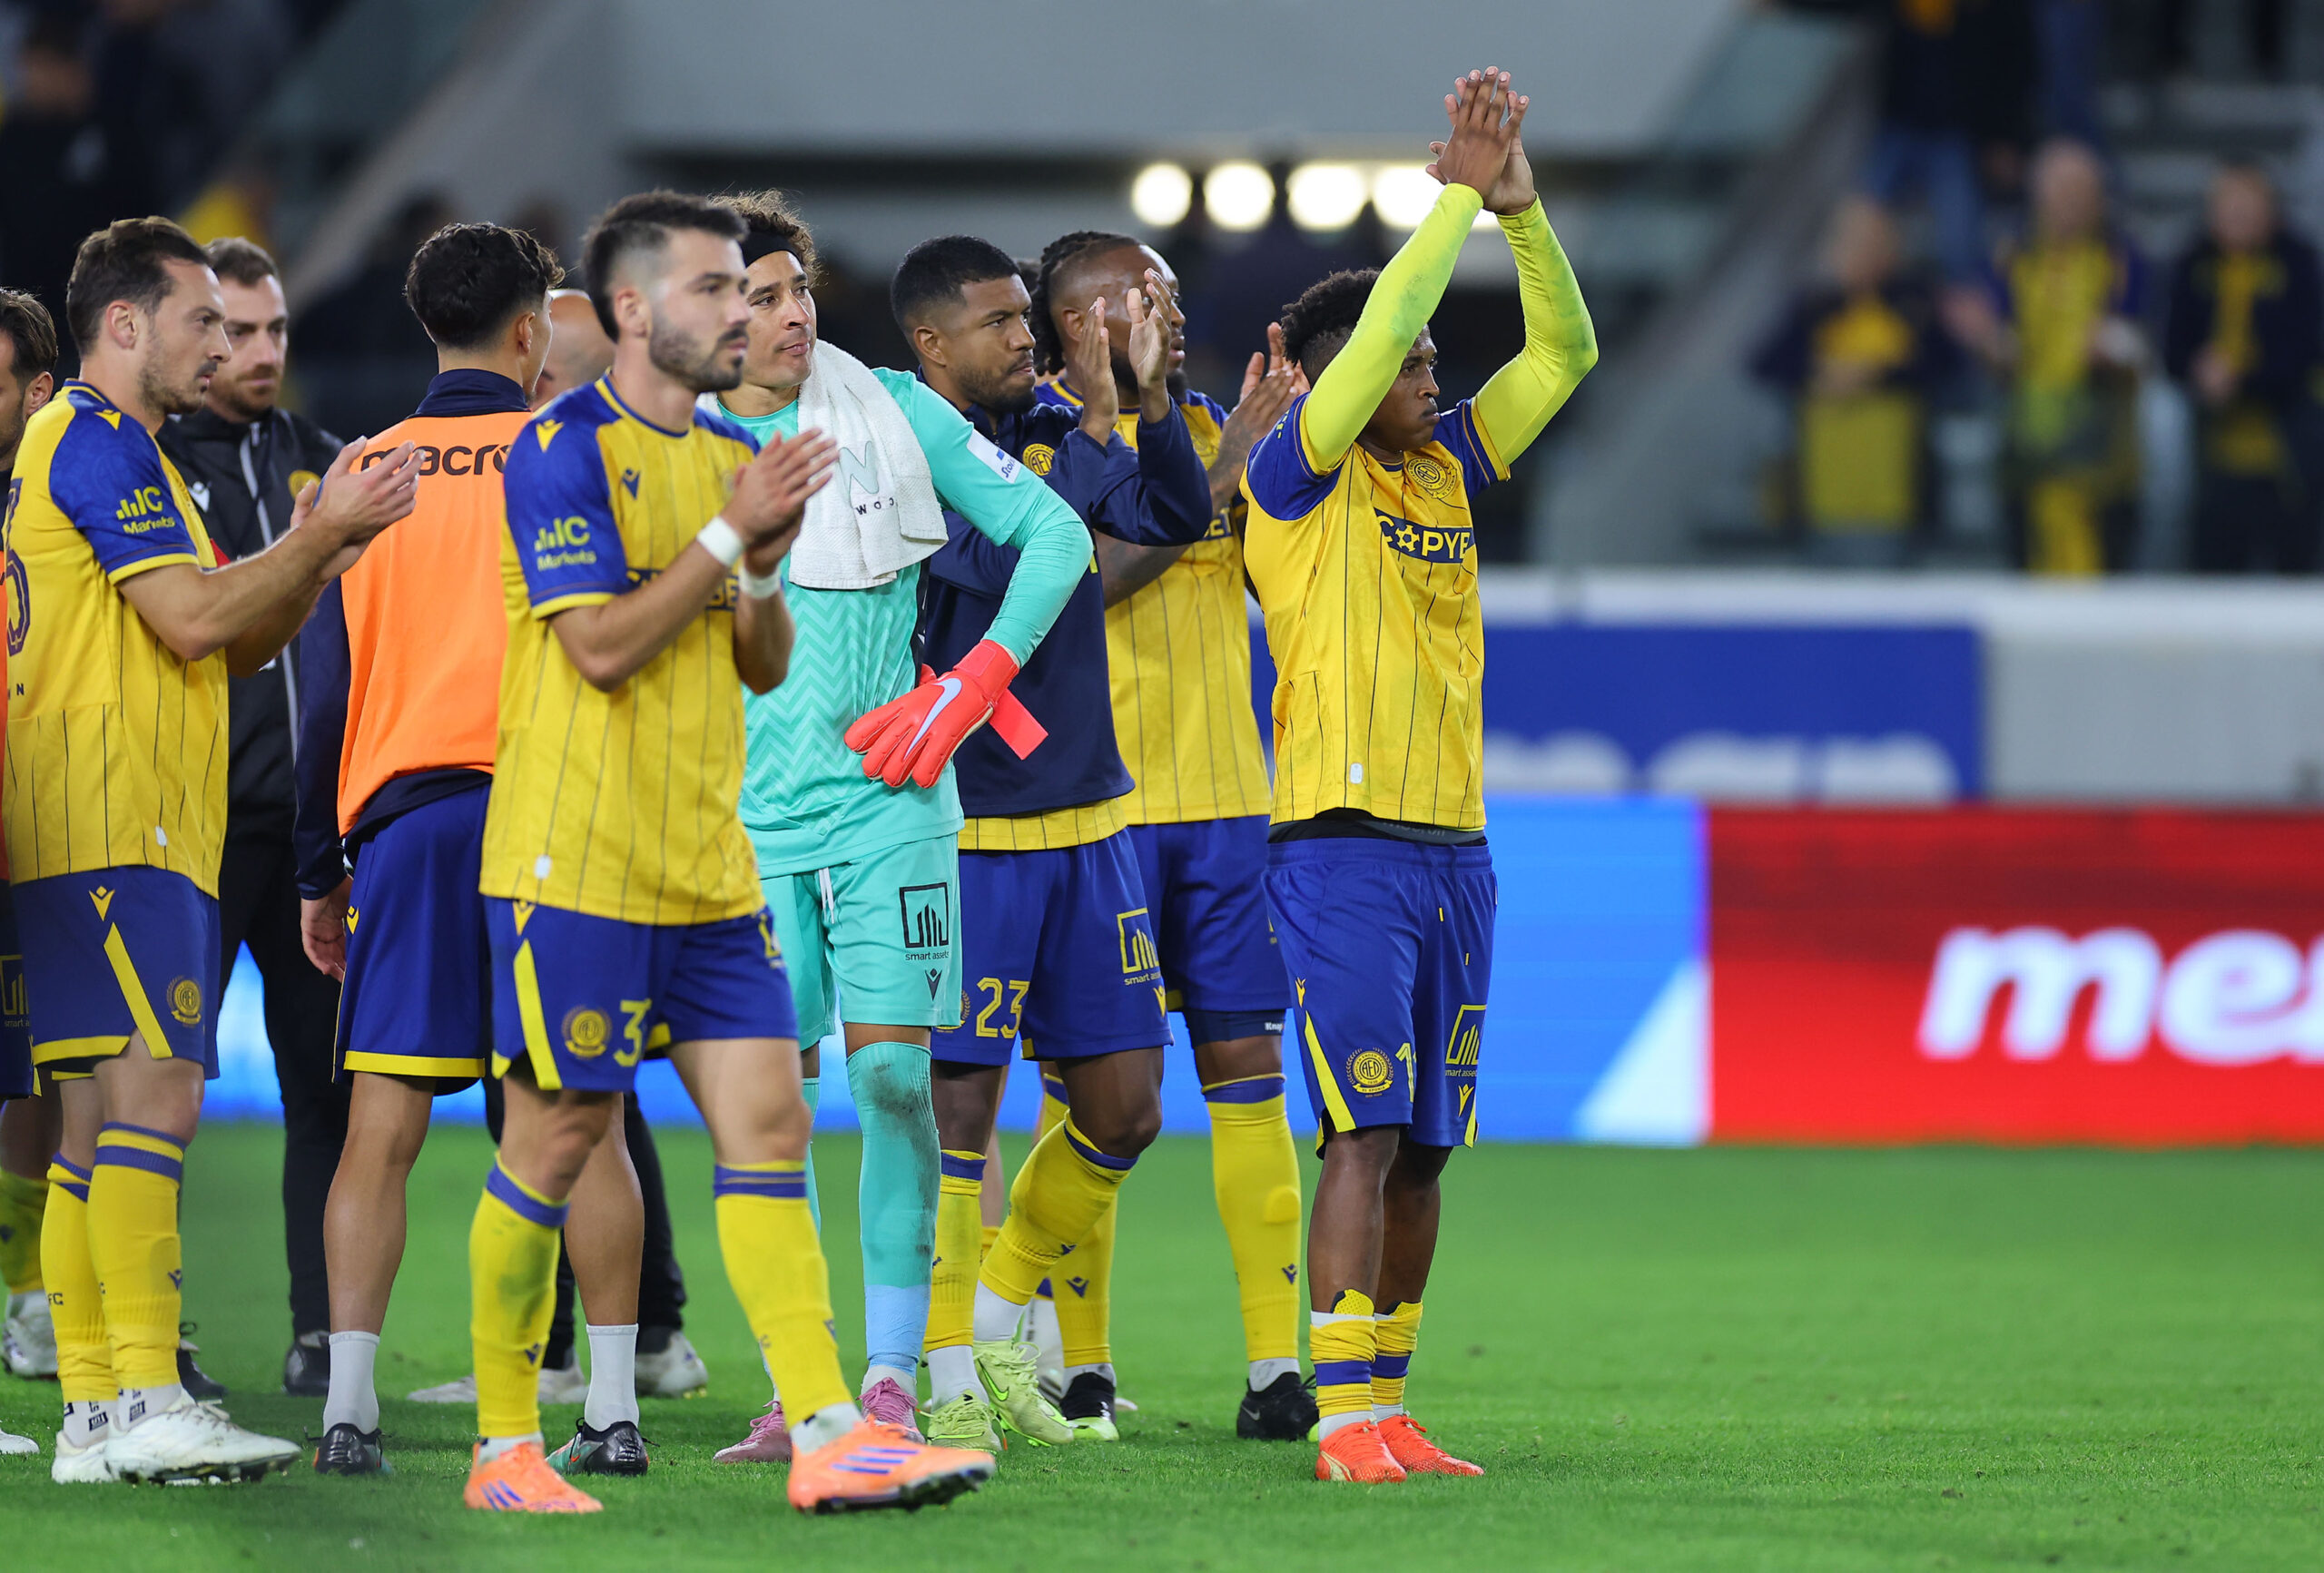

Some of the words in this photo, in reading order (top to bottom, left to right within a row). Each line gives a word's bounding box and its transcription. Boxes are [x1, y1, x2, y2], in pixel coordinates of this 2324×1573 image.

[123, 515, 176, 535] Markets
[537, 549, 597, 573] Markets
[905, 951, 931, 961] smart
[1124, 973, 1150, 986] smart
[976, 977, 1030, 1039] 23
[1918, 927, 2324, 1066] me
[613, 998, 653, 1067] 3
[1395, 1042, 1416, 1103] 1
[1444, 1068, 1462, 1077] mart
